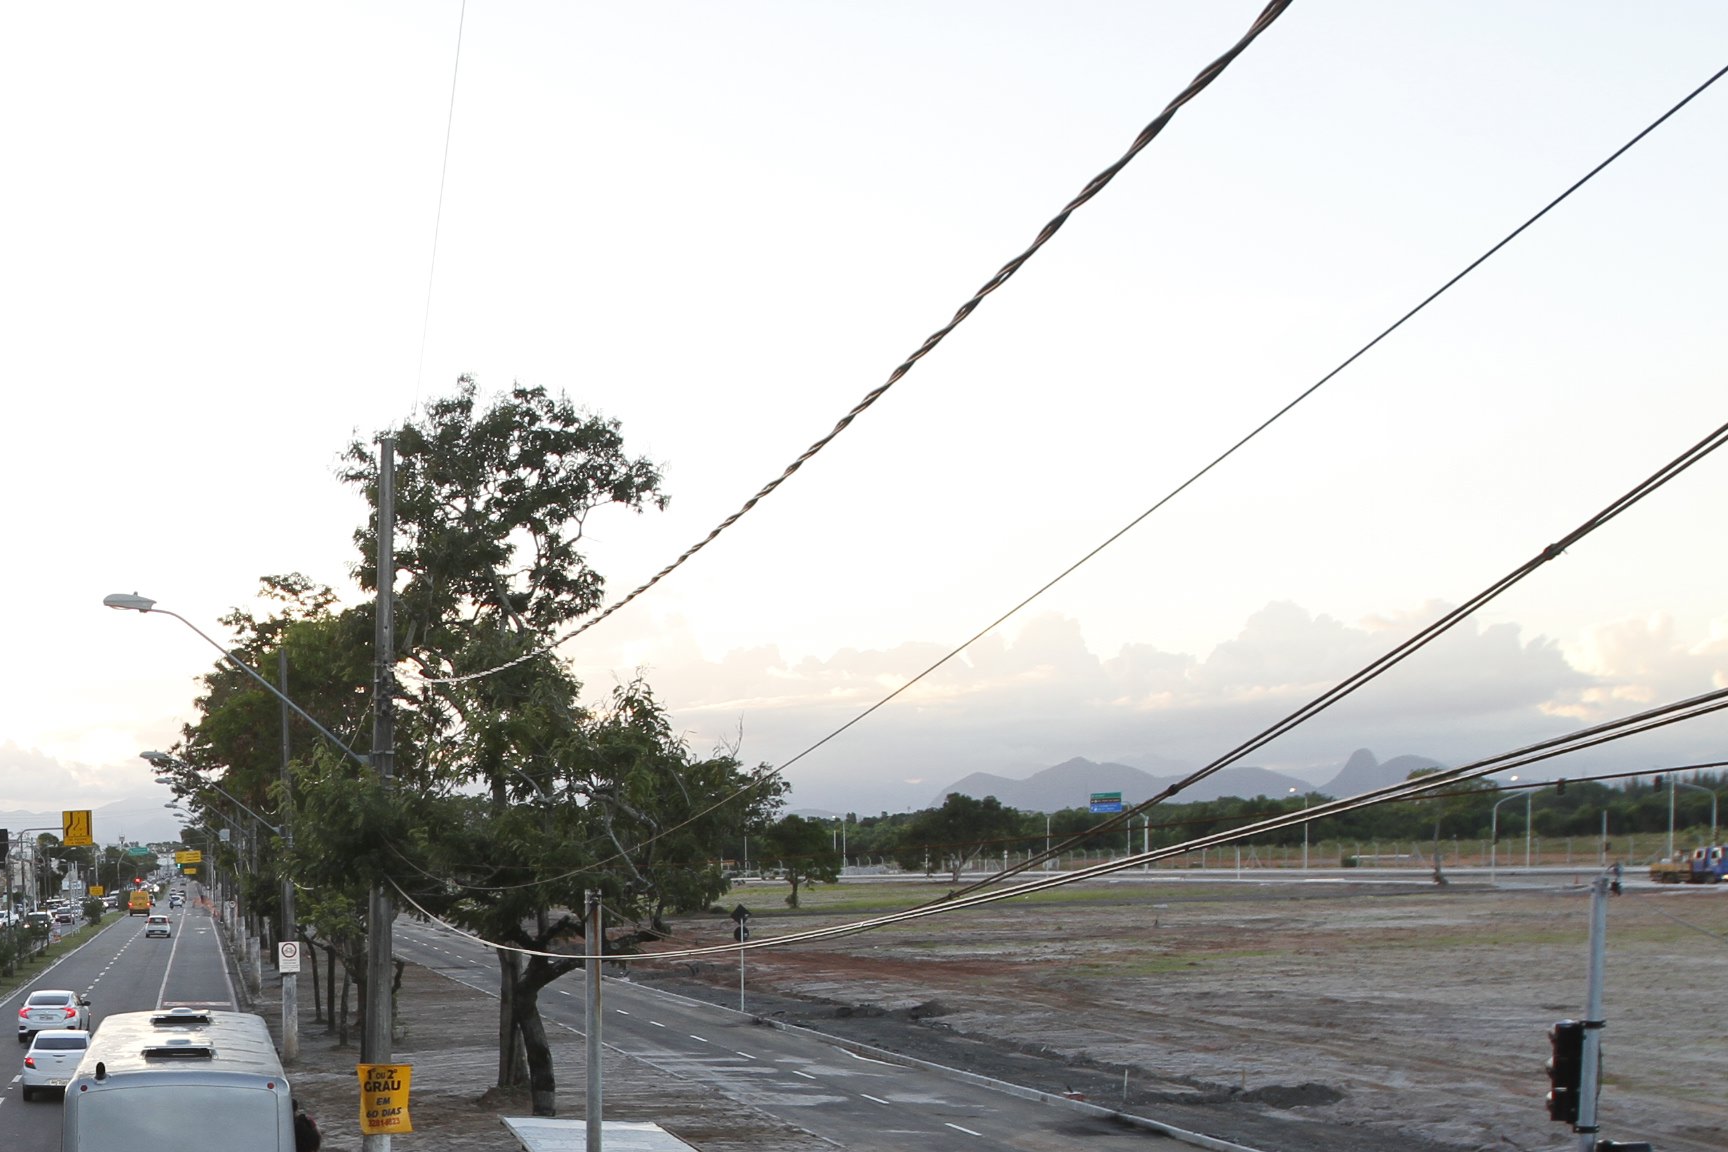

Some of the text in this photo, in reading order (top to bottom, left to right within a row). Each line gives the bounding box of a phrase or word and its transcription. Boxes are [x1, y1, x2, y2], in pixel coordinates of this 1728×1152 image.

[364, 1080, 401, 1092] GRAU
[377, 1097, 390, 1105] EM
[382, 1107, 401, 1117] DIAS
